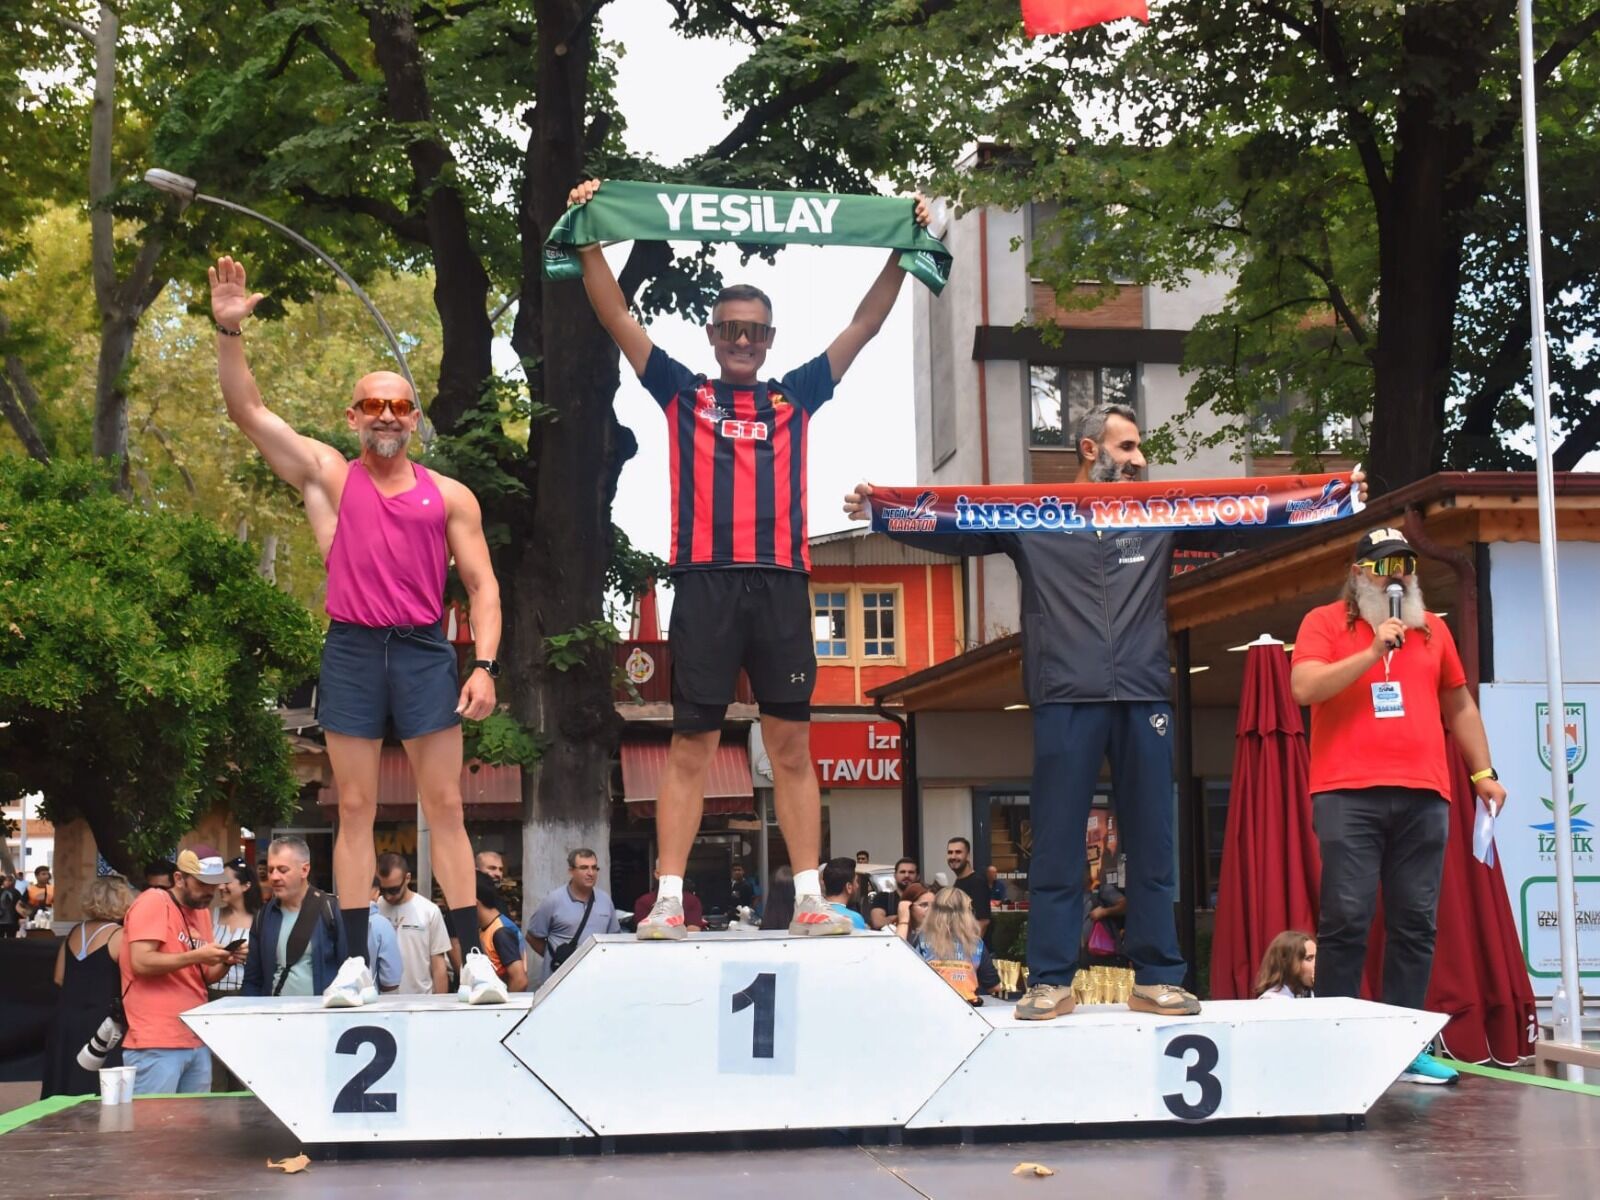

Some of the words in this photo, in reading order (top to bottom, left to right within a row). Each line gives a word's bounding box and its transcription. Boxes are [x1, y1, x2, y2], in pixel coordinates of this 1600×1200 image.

[656, 192, 841, 237] YEŞİLAY
[888, 518, 937, 532] MARATON
[956, 495, 1086, 529] İNEGÖL
[1091, 496, 1268, 527] MARATON
[817, 758, 901, 781] TAVUK
[732, 972, 777, 1059] 1
[332, 1025, 398, 1113] 2
[1162, 1034, 1223, 1120] 3
